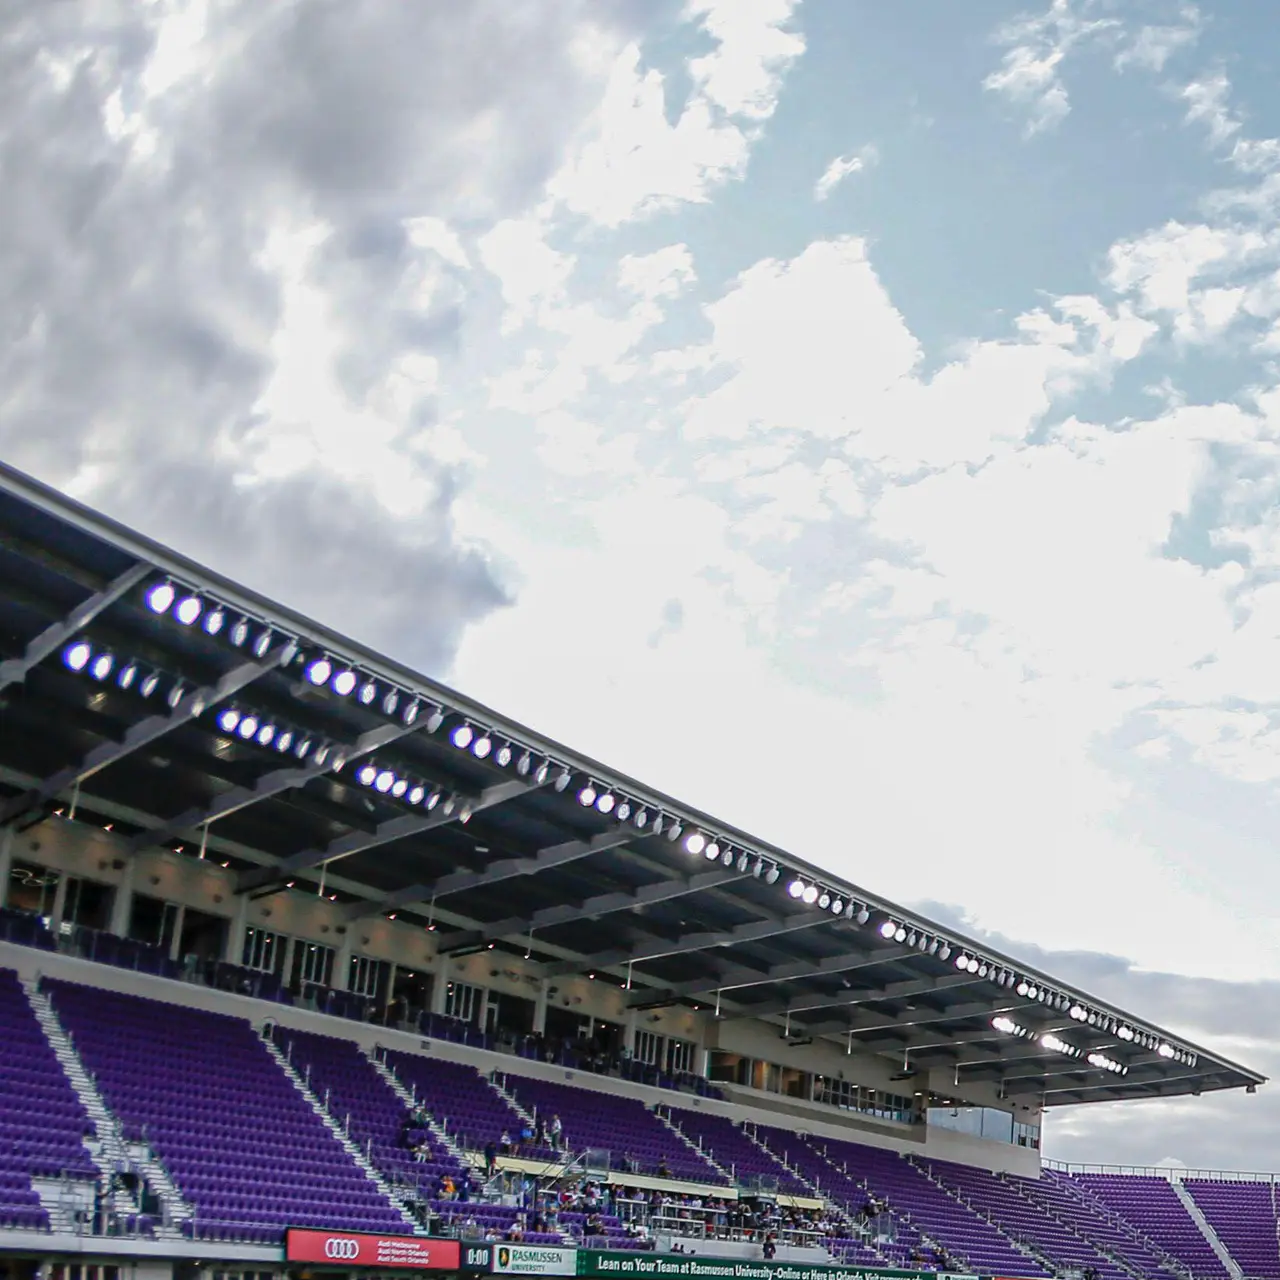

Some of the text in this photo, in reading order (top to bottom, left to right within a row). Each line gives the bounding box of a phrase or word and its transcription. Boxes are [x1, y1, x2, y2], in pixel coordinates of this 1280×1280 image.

[511, 1249, 563, 1264] RASMUSSEN
[511, 1263, 545, 1273] UNIVERSITY
[598, 1256, 620, 1270] Lean
[621, 1261, 634, 1272] on
[635, 1258, 655, 1272] Your
[657, 1260, 680, 1274] Team
[681, 1263, 690, 1275] at
[690, 1261, 734, 1277] Rasmussen
[801, 1270, 810, 1280] or
[811, 1268, 828, 1280] Here
